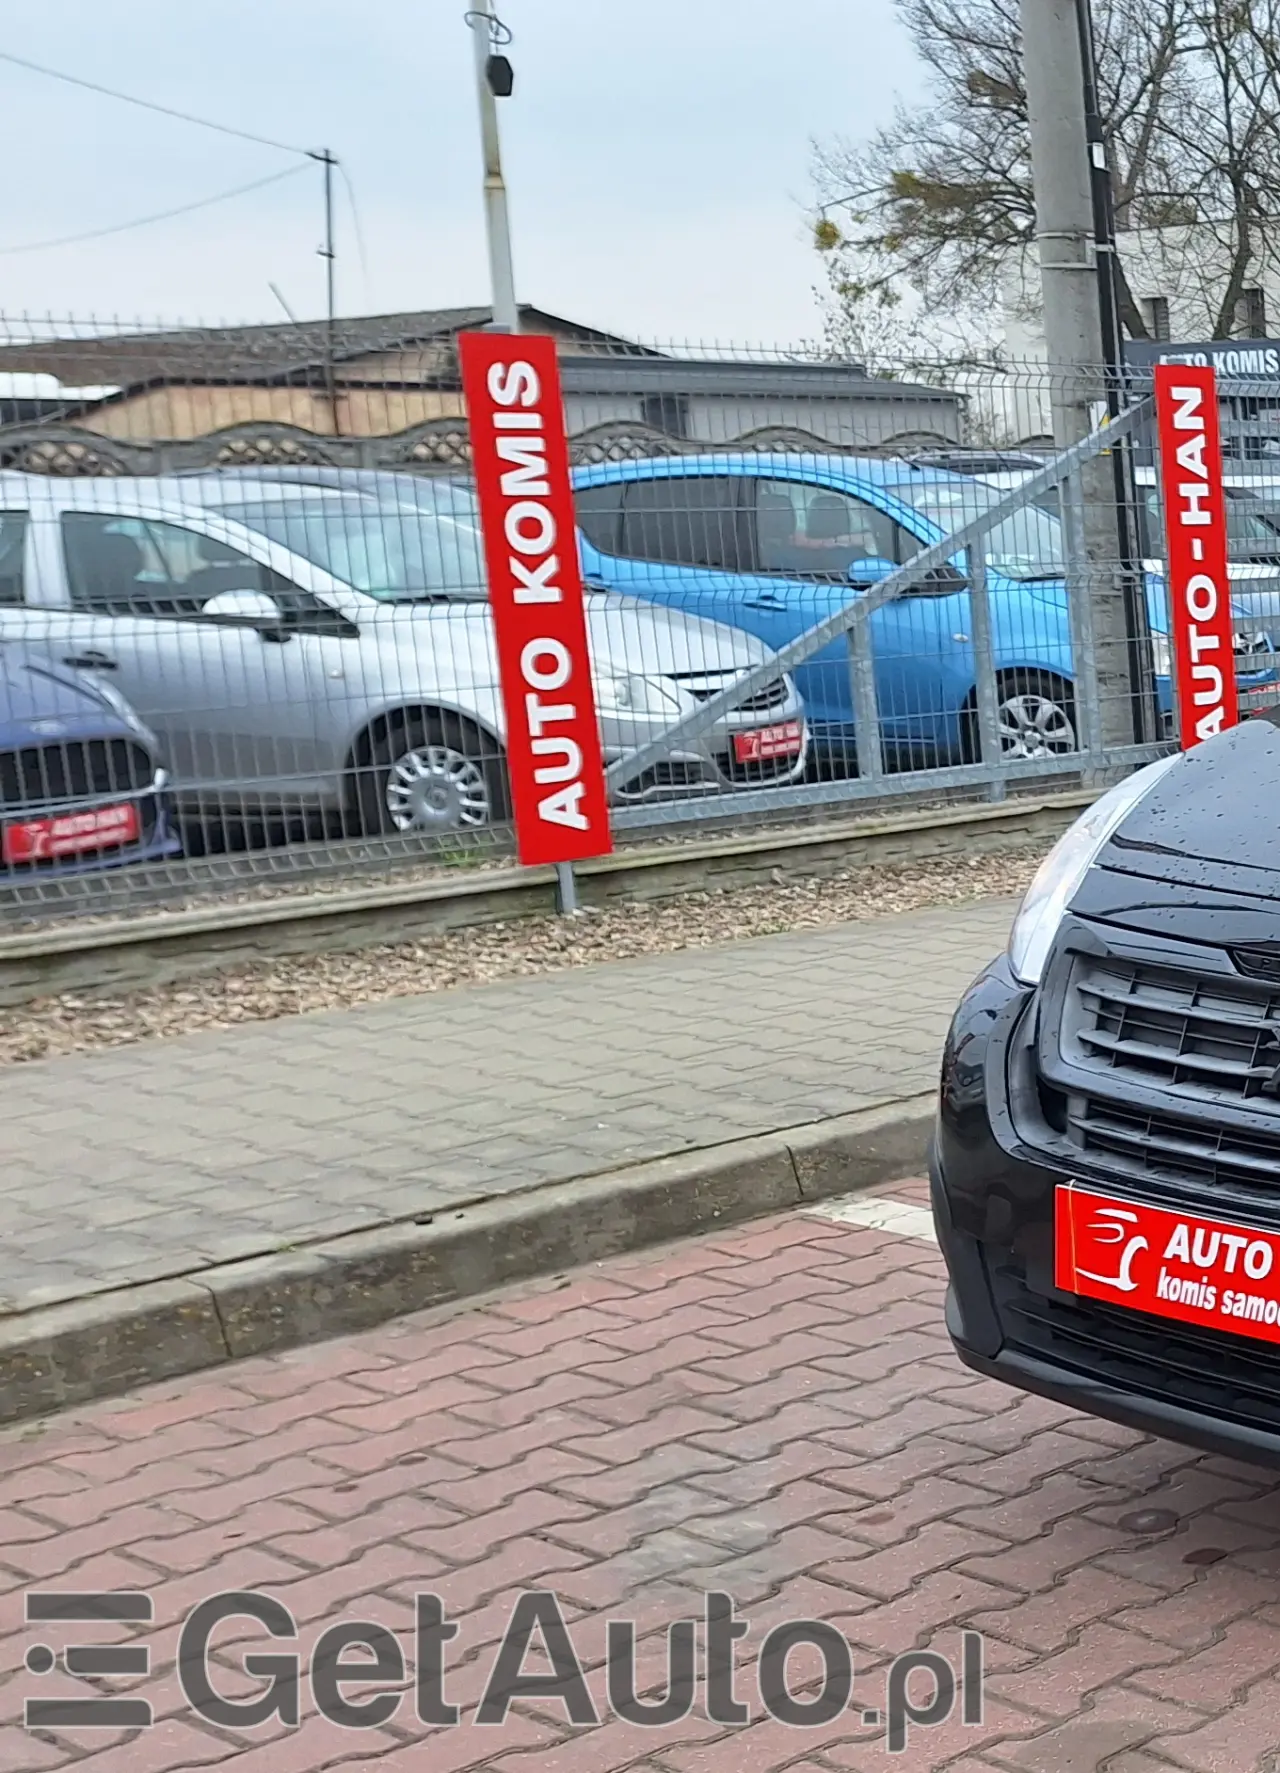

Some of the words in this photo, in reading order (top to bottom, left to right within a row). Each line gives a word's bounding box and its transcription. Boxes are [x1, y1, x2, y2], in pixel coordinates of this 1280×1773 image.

[1212, 349, 1279, 374] KOMIS
[487, 360, 563, 604] KOMIS
[520, 637, 590, 832] AUTO
[1162, 1223, 1273, 1280] AUTO
[1156, 1267, 1217, 1311] komis
